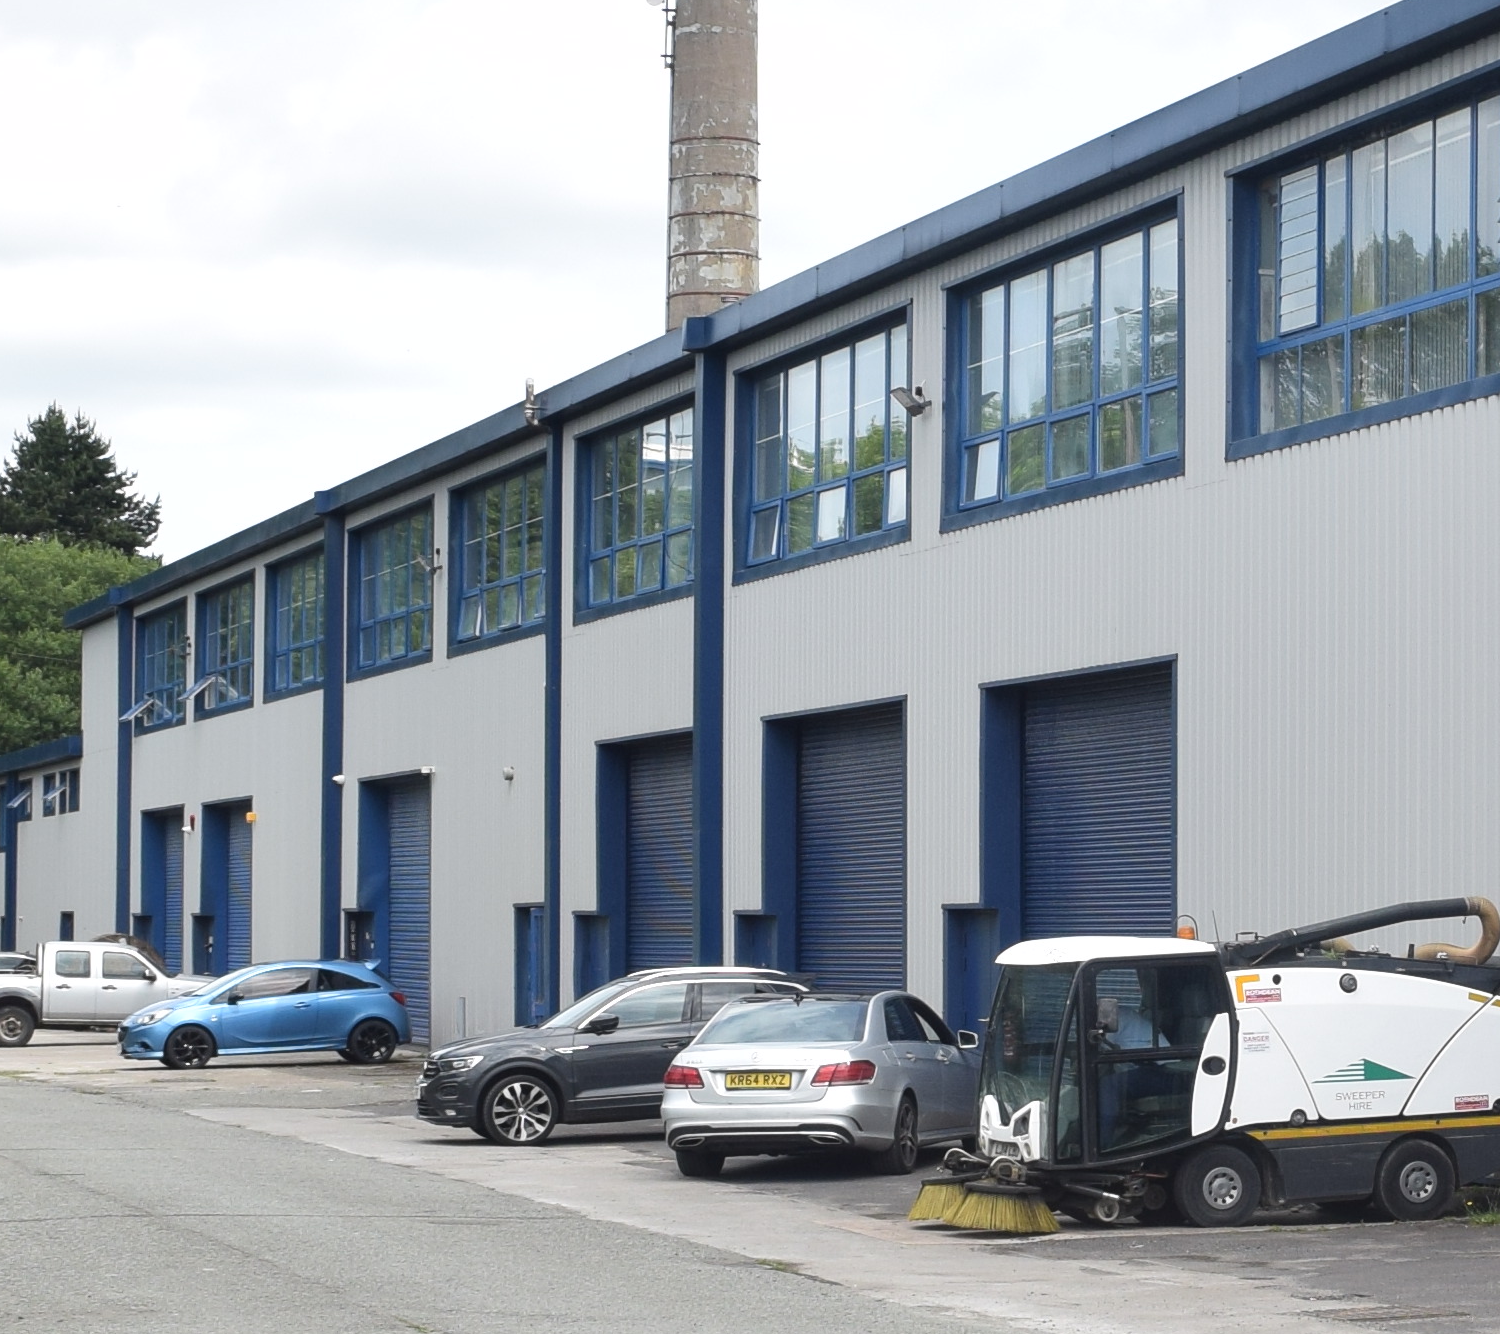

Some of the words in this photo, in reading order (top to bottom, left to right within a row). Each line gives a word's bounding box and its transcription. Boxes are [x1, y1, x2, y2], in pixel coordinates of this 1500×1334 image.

[729, 1075, 759, 1086] KR64
[763, 1075, 786, 1086] RXZ
[1335, 1090, 1386, 1101] SWEEPER
[1348, 1101, 1372, 1111] HIRE
